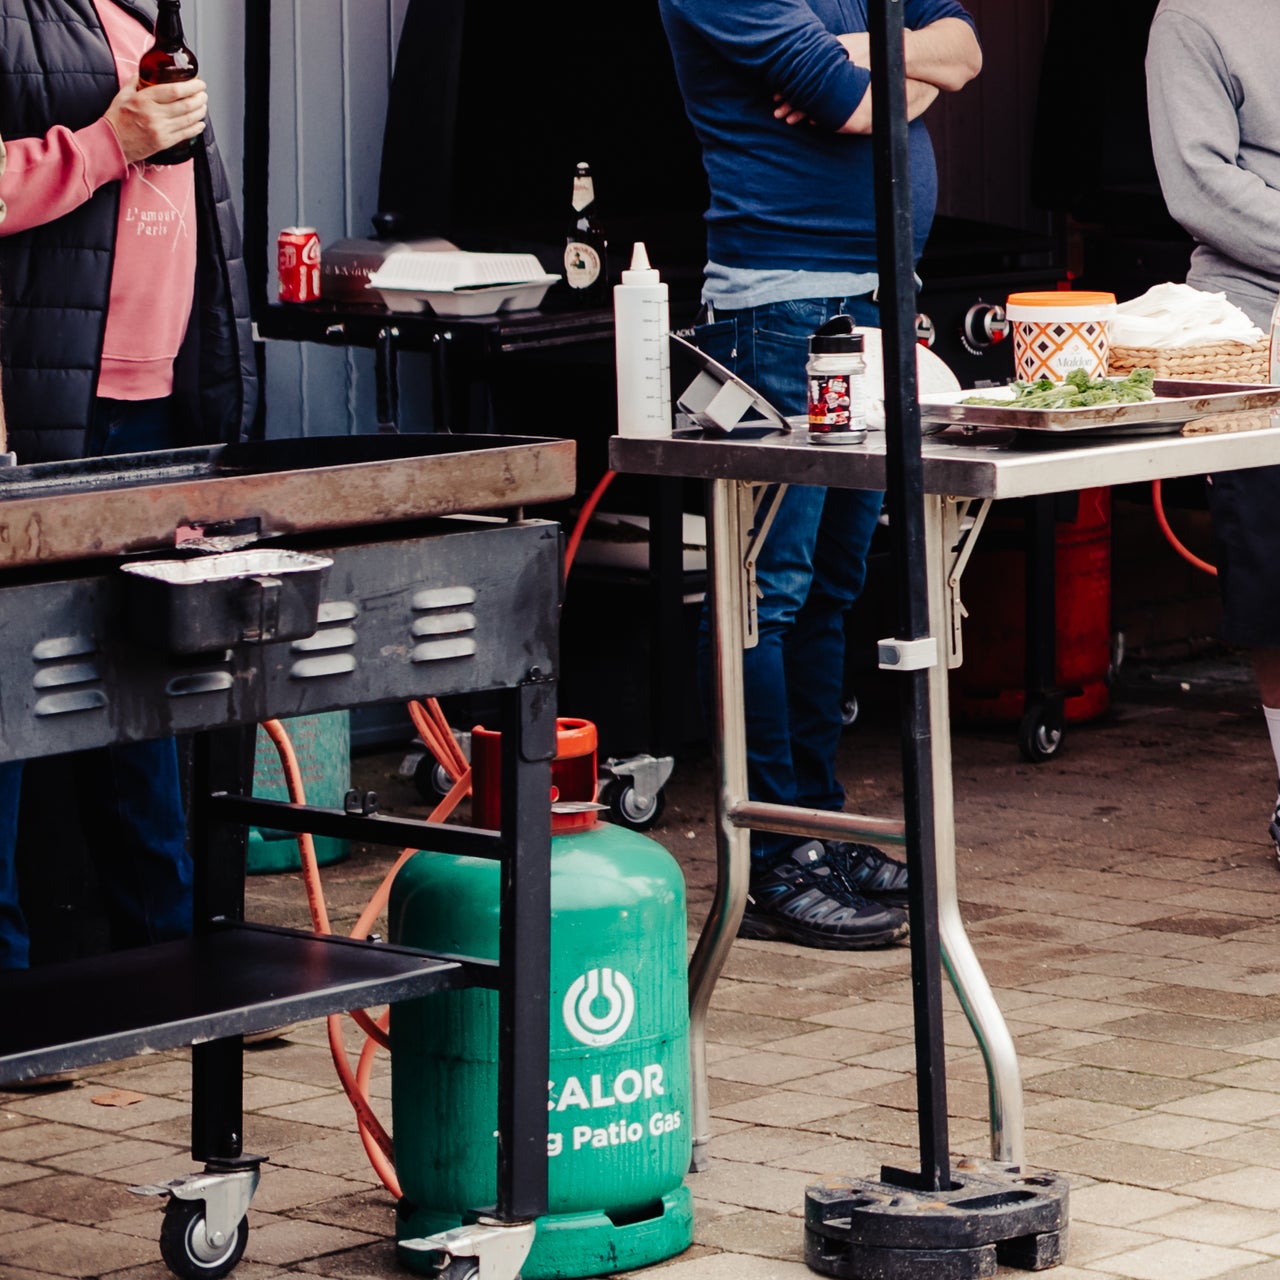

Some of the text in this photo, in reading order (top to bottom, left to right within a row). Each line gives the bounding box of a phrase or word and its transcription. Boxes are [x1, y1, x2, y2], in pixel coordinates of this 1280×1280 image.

[126, 207, 177, 221] L'amour
[137, 222, 168, 235] Paris
[1056, 355, 1093, 368] Maldon
[572, 1119, 643, 1150] Patio
[649, 1110, 681, 1136] Gas
